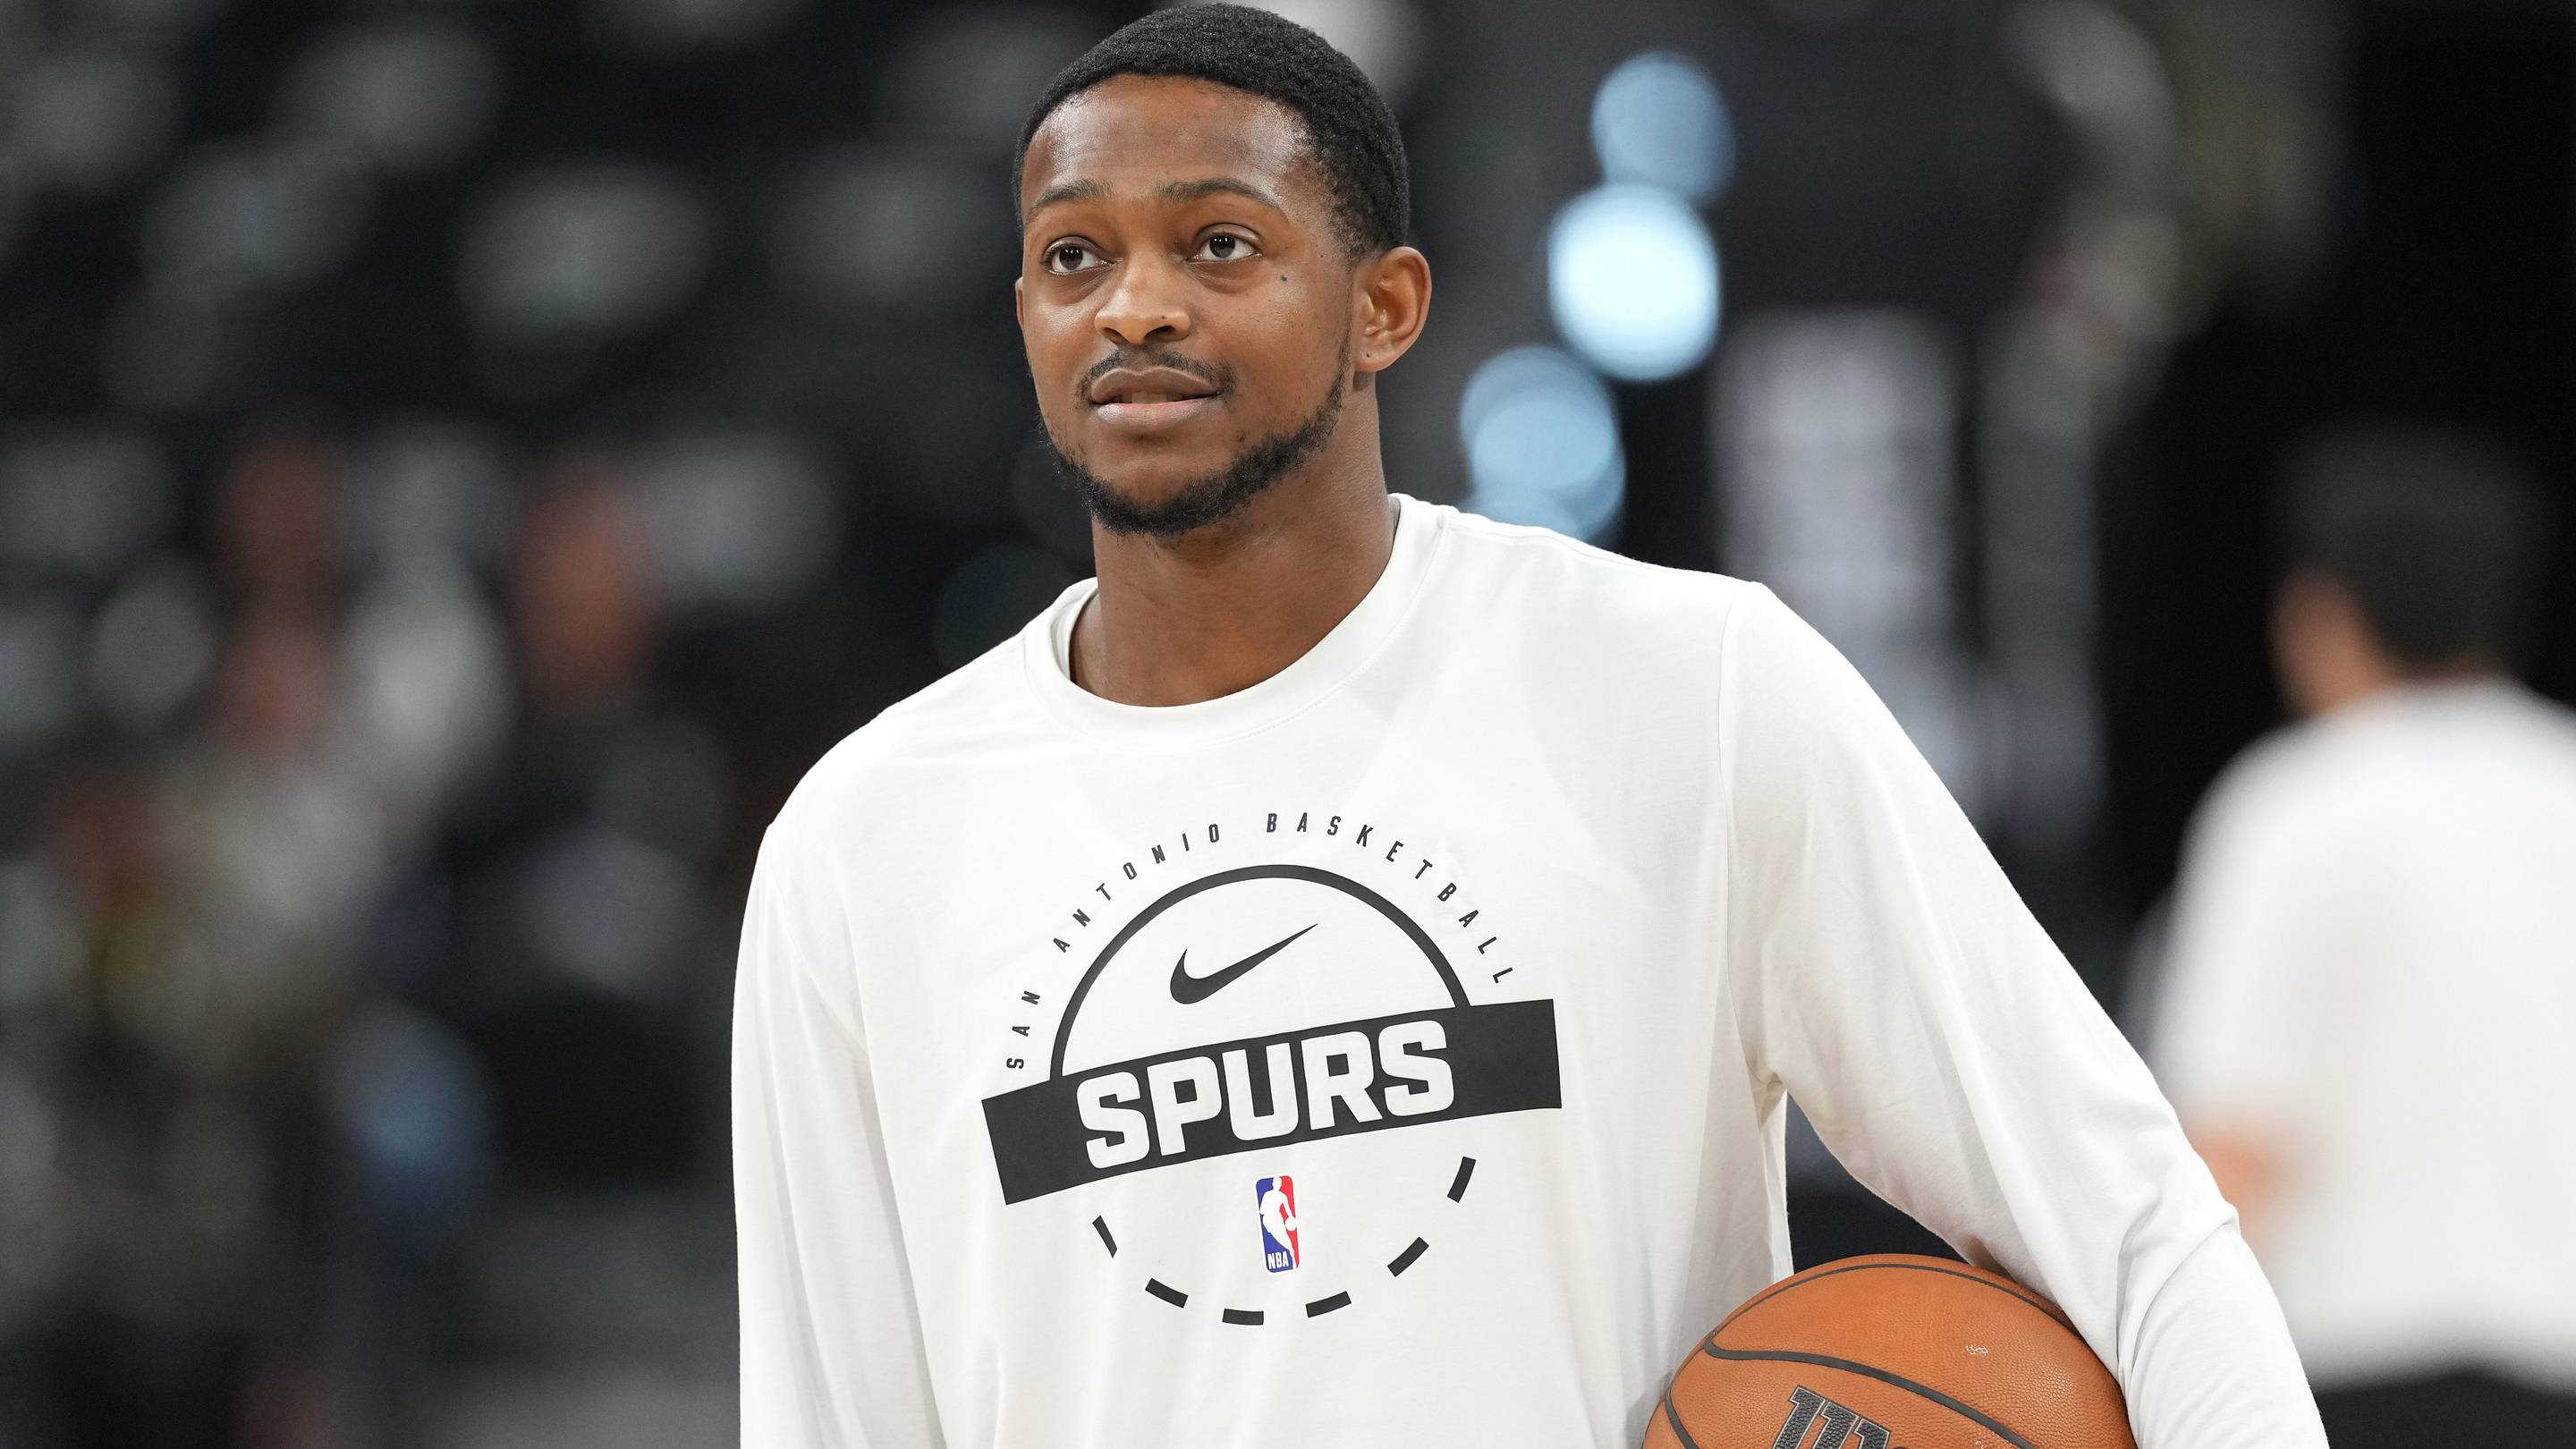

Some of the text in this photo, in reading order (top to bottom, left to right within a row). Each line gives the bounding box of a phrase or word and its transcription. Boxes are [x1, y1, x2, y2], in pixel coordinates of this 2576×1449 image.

[1005, 811, 1513, 1071] SAN ANTONIO BASKETBALL
[1076, 1020, 1455, 1169] SPURS
[1267, 1250, 1290, 1270] NBA
